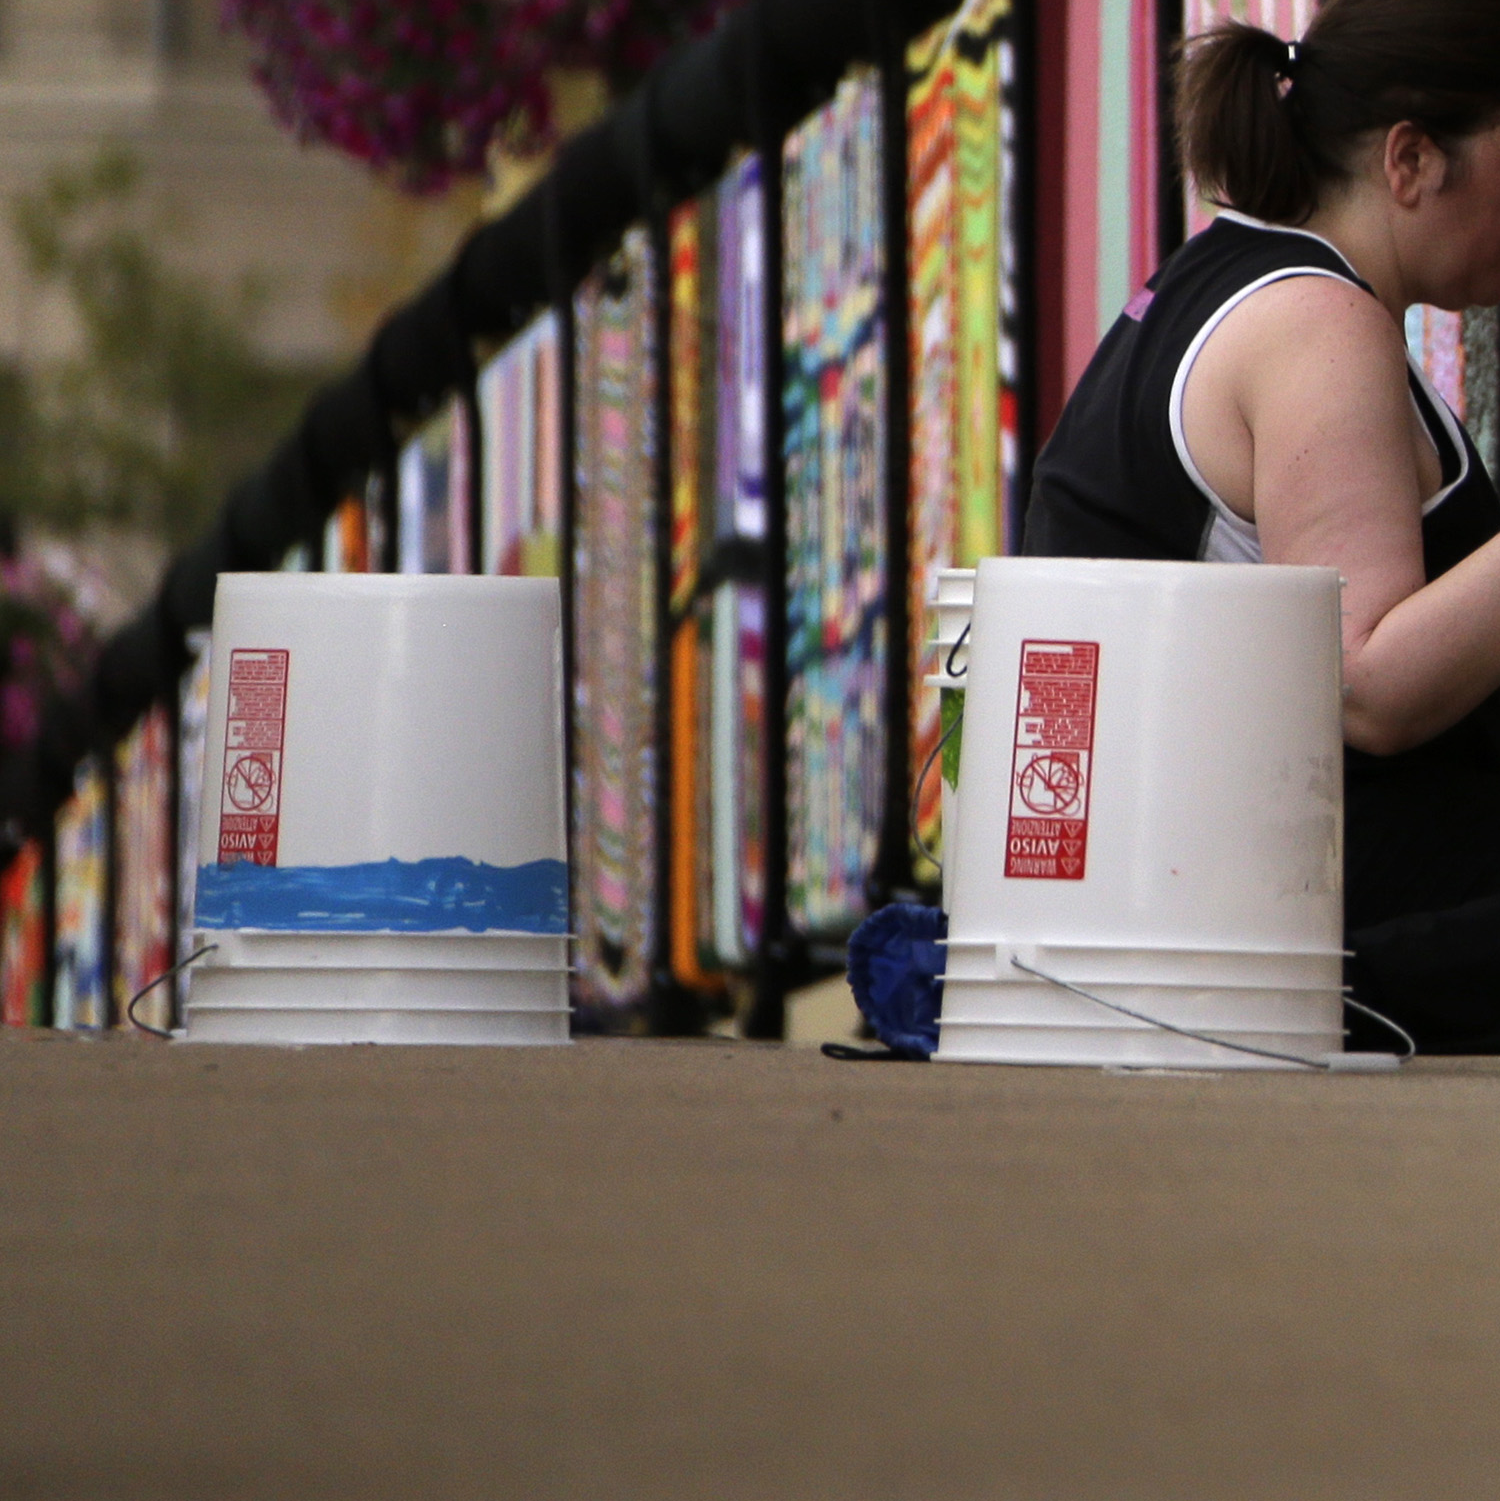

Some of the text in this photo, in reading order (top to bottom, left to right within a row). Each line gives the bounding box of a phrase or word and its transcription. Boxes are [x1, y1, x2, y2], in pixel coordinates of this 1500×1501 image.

[1011, 819, 1061, 837] ATTENZIONE
[221, 832, 257, 849] AVISO
[1010, 837, 1060, 855] AVISO
